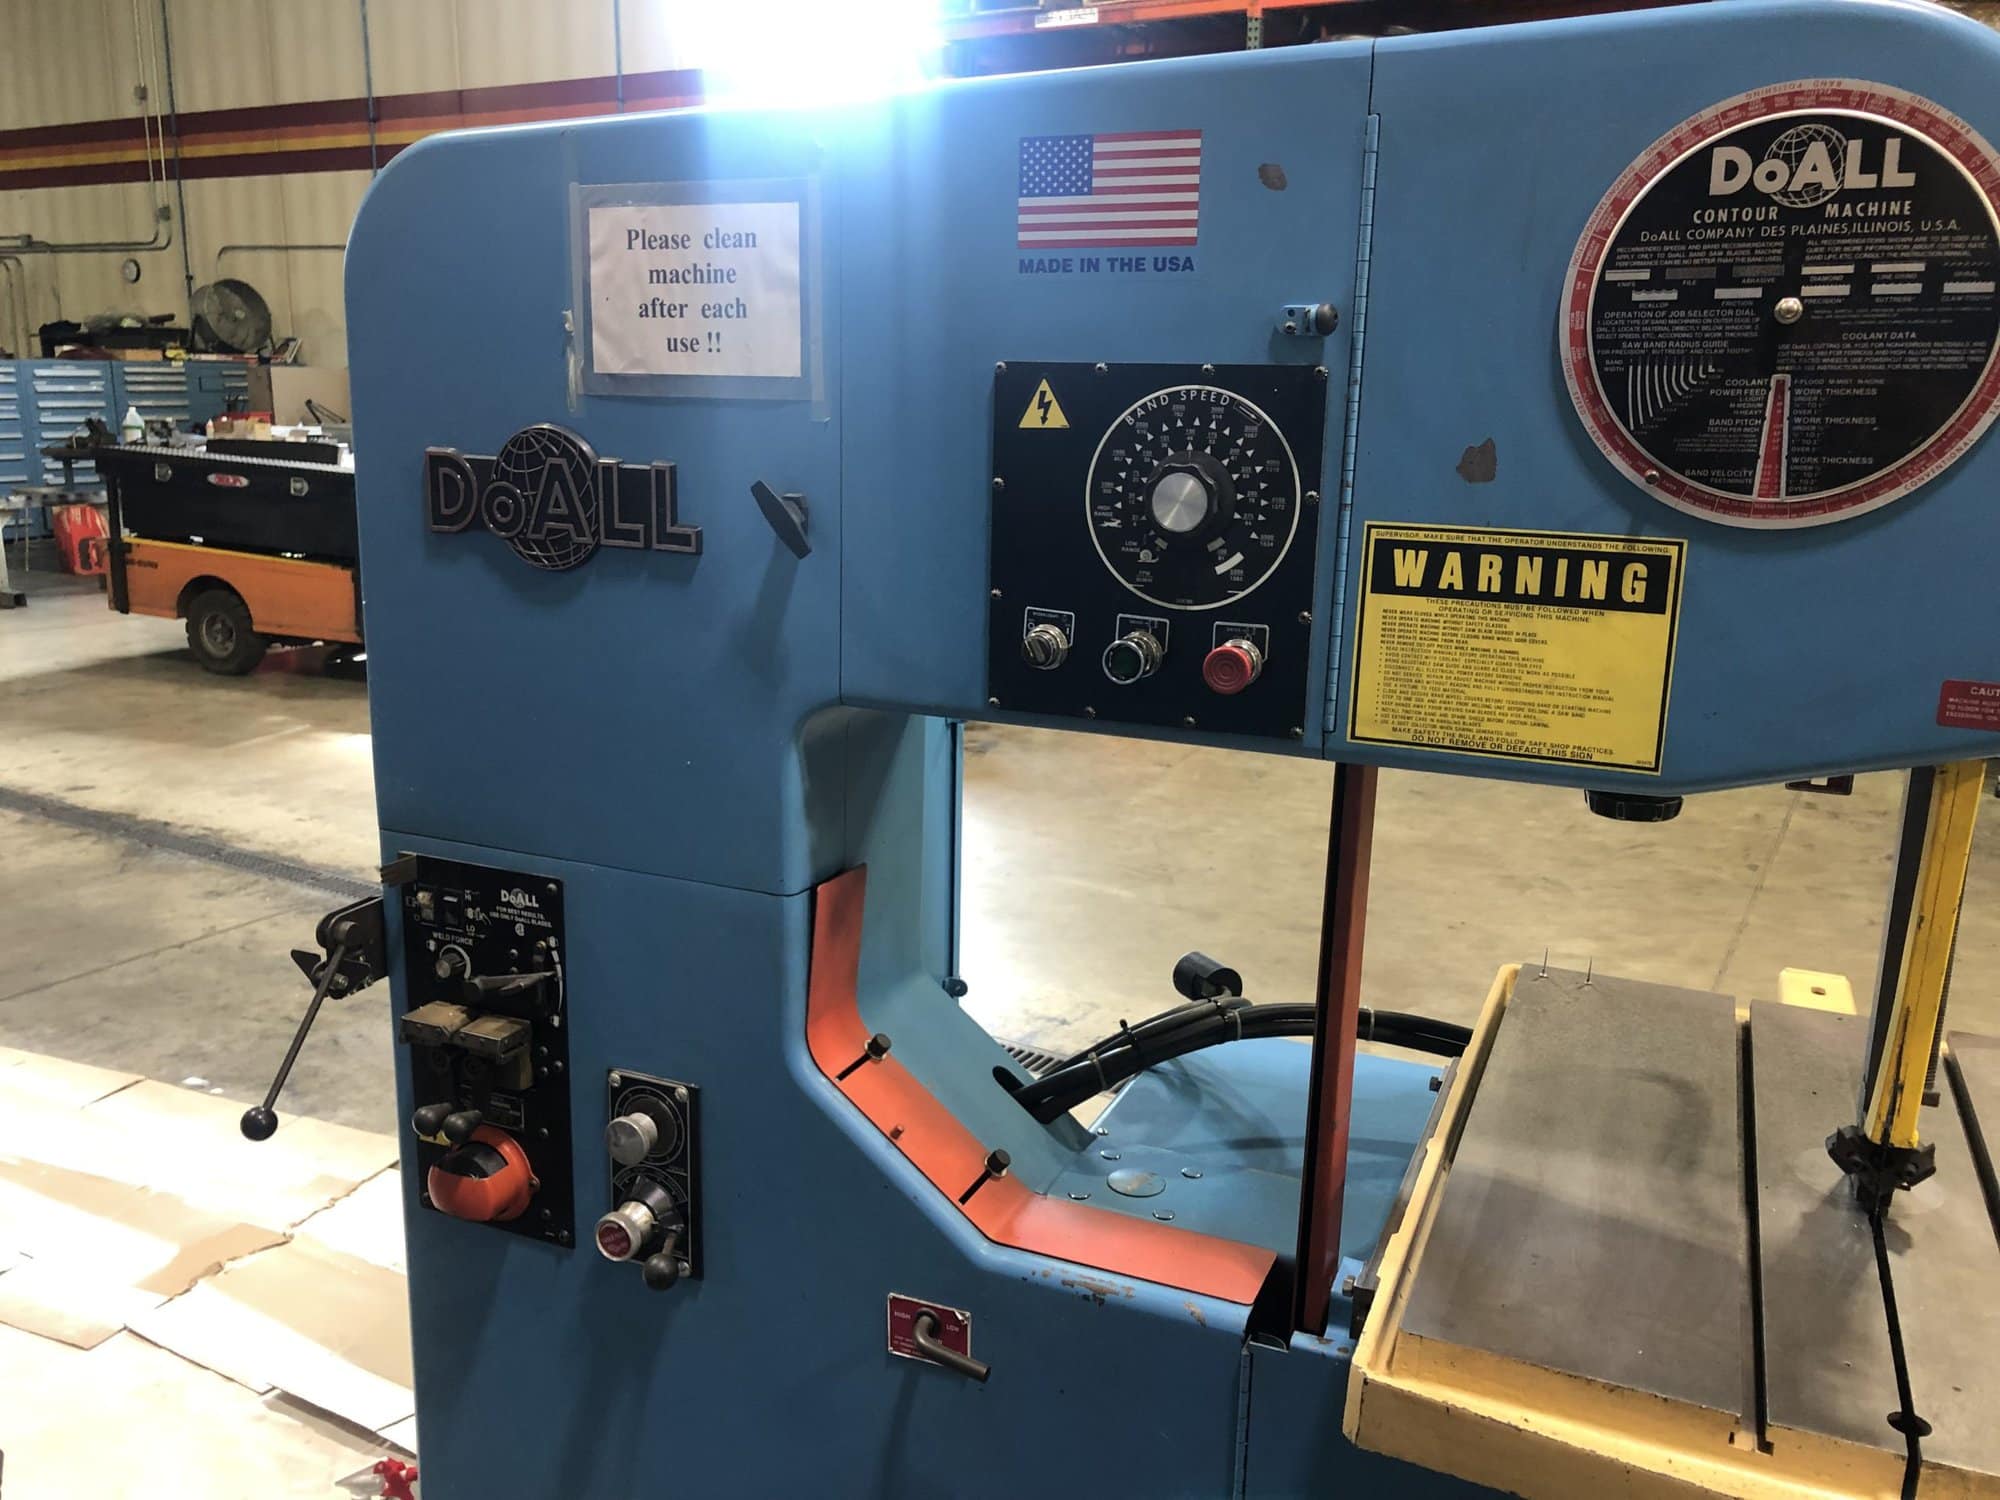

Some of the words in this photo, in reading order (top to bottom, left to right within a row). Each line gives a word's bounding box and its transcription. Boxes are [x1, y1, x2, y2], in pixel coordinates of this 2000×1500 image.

[1743, 81, 1801, 101] POLISHING
[1812, 79, 1842, 87] BAND
[1907, 94, 1942, 115] FILING
[1945, 113, 1973, 136] BAND
[1709, 138, 1916, 196] DoALL
[1692, 206, 1778, 224] CONTOUR
[1824, 200, 1912, 218] MACHINE
[626, 228, 691, 250] Please
[703, 228, 757, 249] clean
[1640, 230, 1681, 242] DoALL
[1686, 226, 1753, 240] COMPANY
[1761, 224, 1786, 237] DES
[1920, 220, 1961, 231] U.S.A.
[648, 262, 736, 284] machine
[1019, 258, 1073, 274] MADE
[1080, 257, 1101, 272] IN
[1107, 257, 1146, 272] THE
[1153, 256, 1195, 272] USA
[638, 298, 688, 318] after
[701, 298, 748, 318] each
[1604, 311, 1652, 319] OPERATION
[1688, 309, 1734, 317] SELECTOR
[666, 336, 700, 352] use
[1125, 394, 1169, 426] BAND
[1180, 390, 1230, 406] SPEED
[1571, 390, 1587, 416] SPEED
[1587, 424, 1613, 456] SAWING
[1903, 434, 1974, 492] CONVENTIONAL
[425, 447, 702, 553] DoALL
[1504, 537, 1544, 545] OPERATOR
[1546, 540, 1602, 549] UNDERSTANDS
[1393, 549, 1648, 604] WARNING
[1438, 605, 1479, 614] OPERATING
[1494, 610, 1533, 618] SERVICING
[1450, 600, 1501, 608] PRECAUTIONS
[1427, 735, 1444, 744] NOT
[1448, 738, 1487, 748] REMOVE
[1506, 744, 1544, 754] DEFACE
[1546, 748, 1566, 757] THIS
[1570, 751, 1592, 760] SIGN
[500, 888, 539, 907] DoALL
[432, 932, 449, 940] WELD
[451, 934, 473, 945] FORCE
